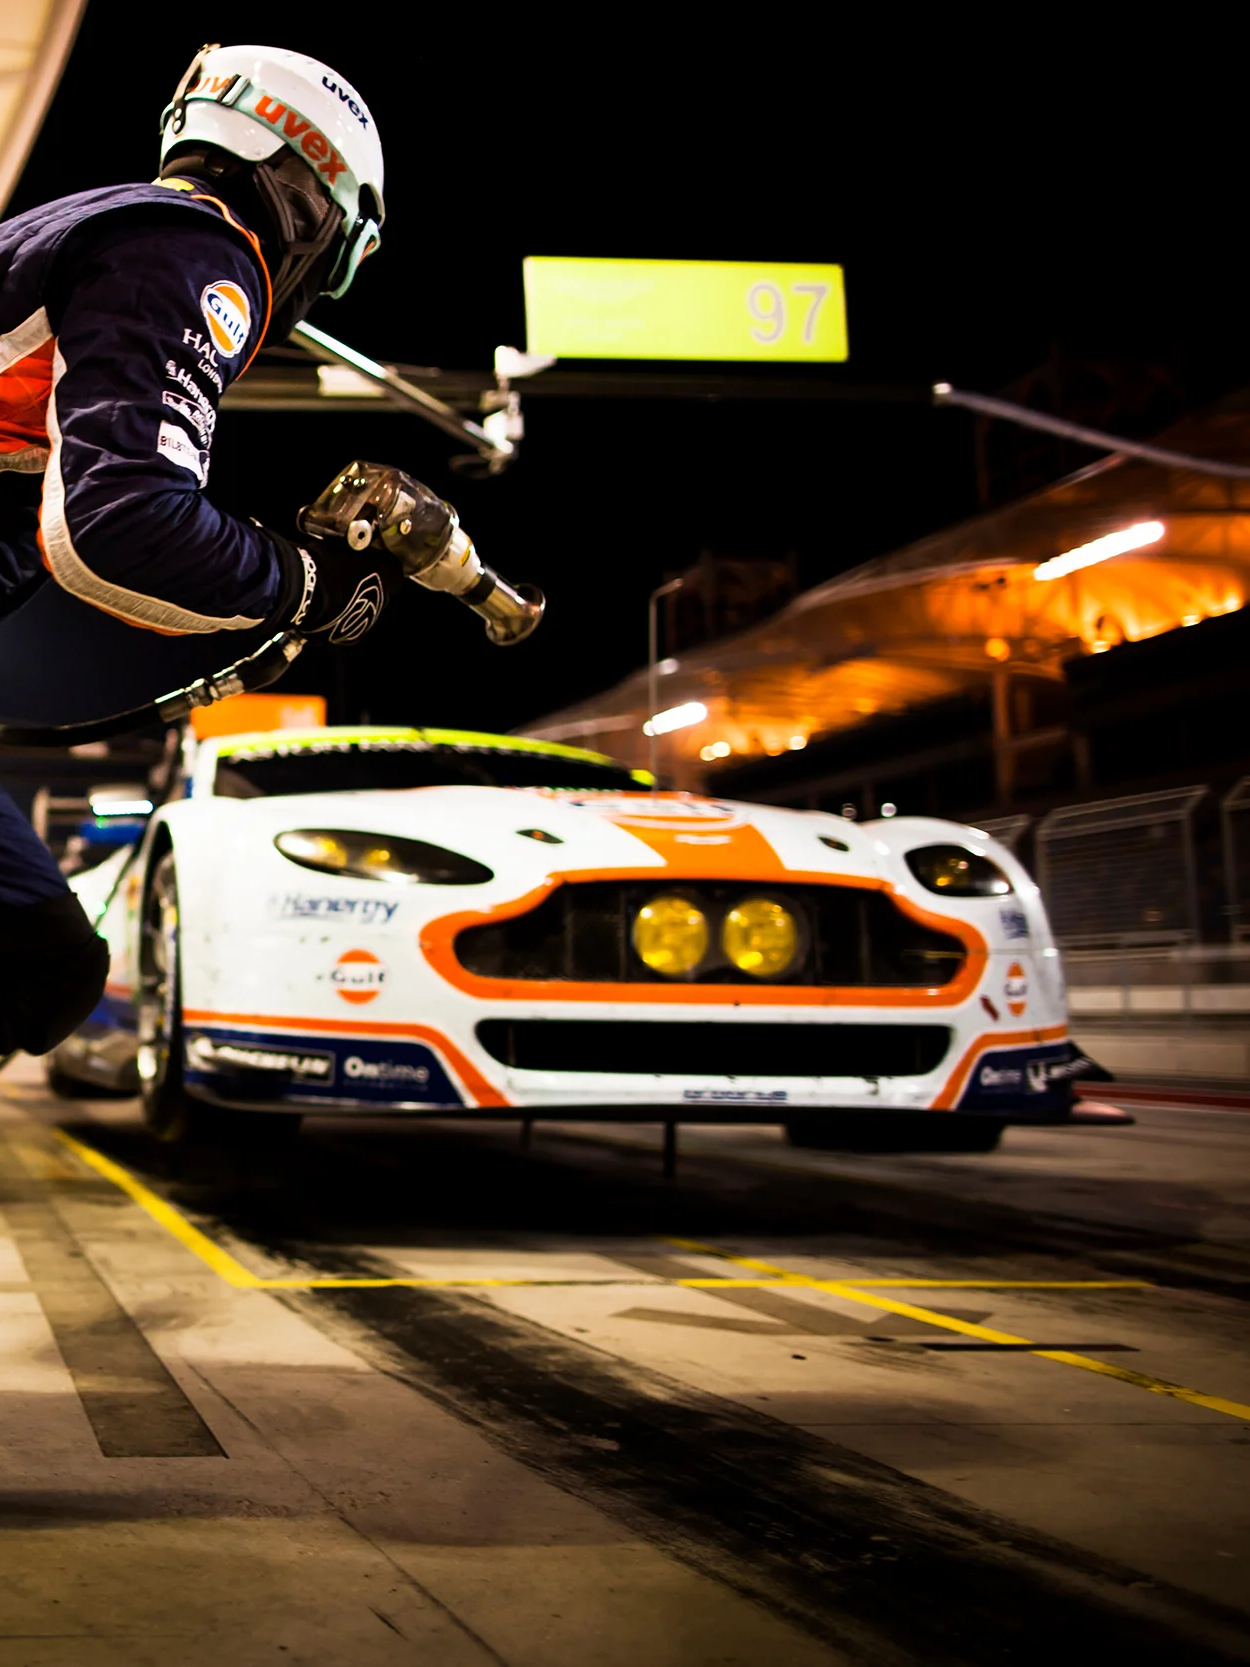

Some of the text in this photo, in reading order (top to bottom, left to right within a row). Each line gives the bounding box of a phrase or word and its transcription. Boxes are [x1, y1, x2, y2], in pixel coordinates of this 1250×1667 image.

[321, 74, 369, 131] uvex
[254, 94, 348, 186] uvex
[746, 283, 830, 345] 97
